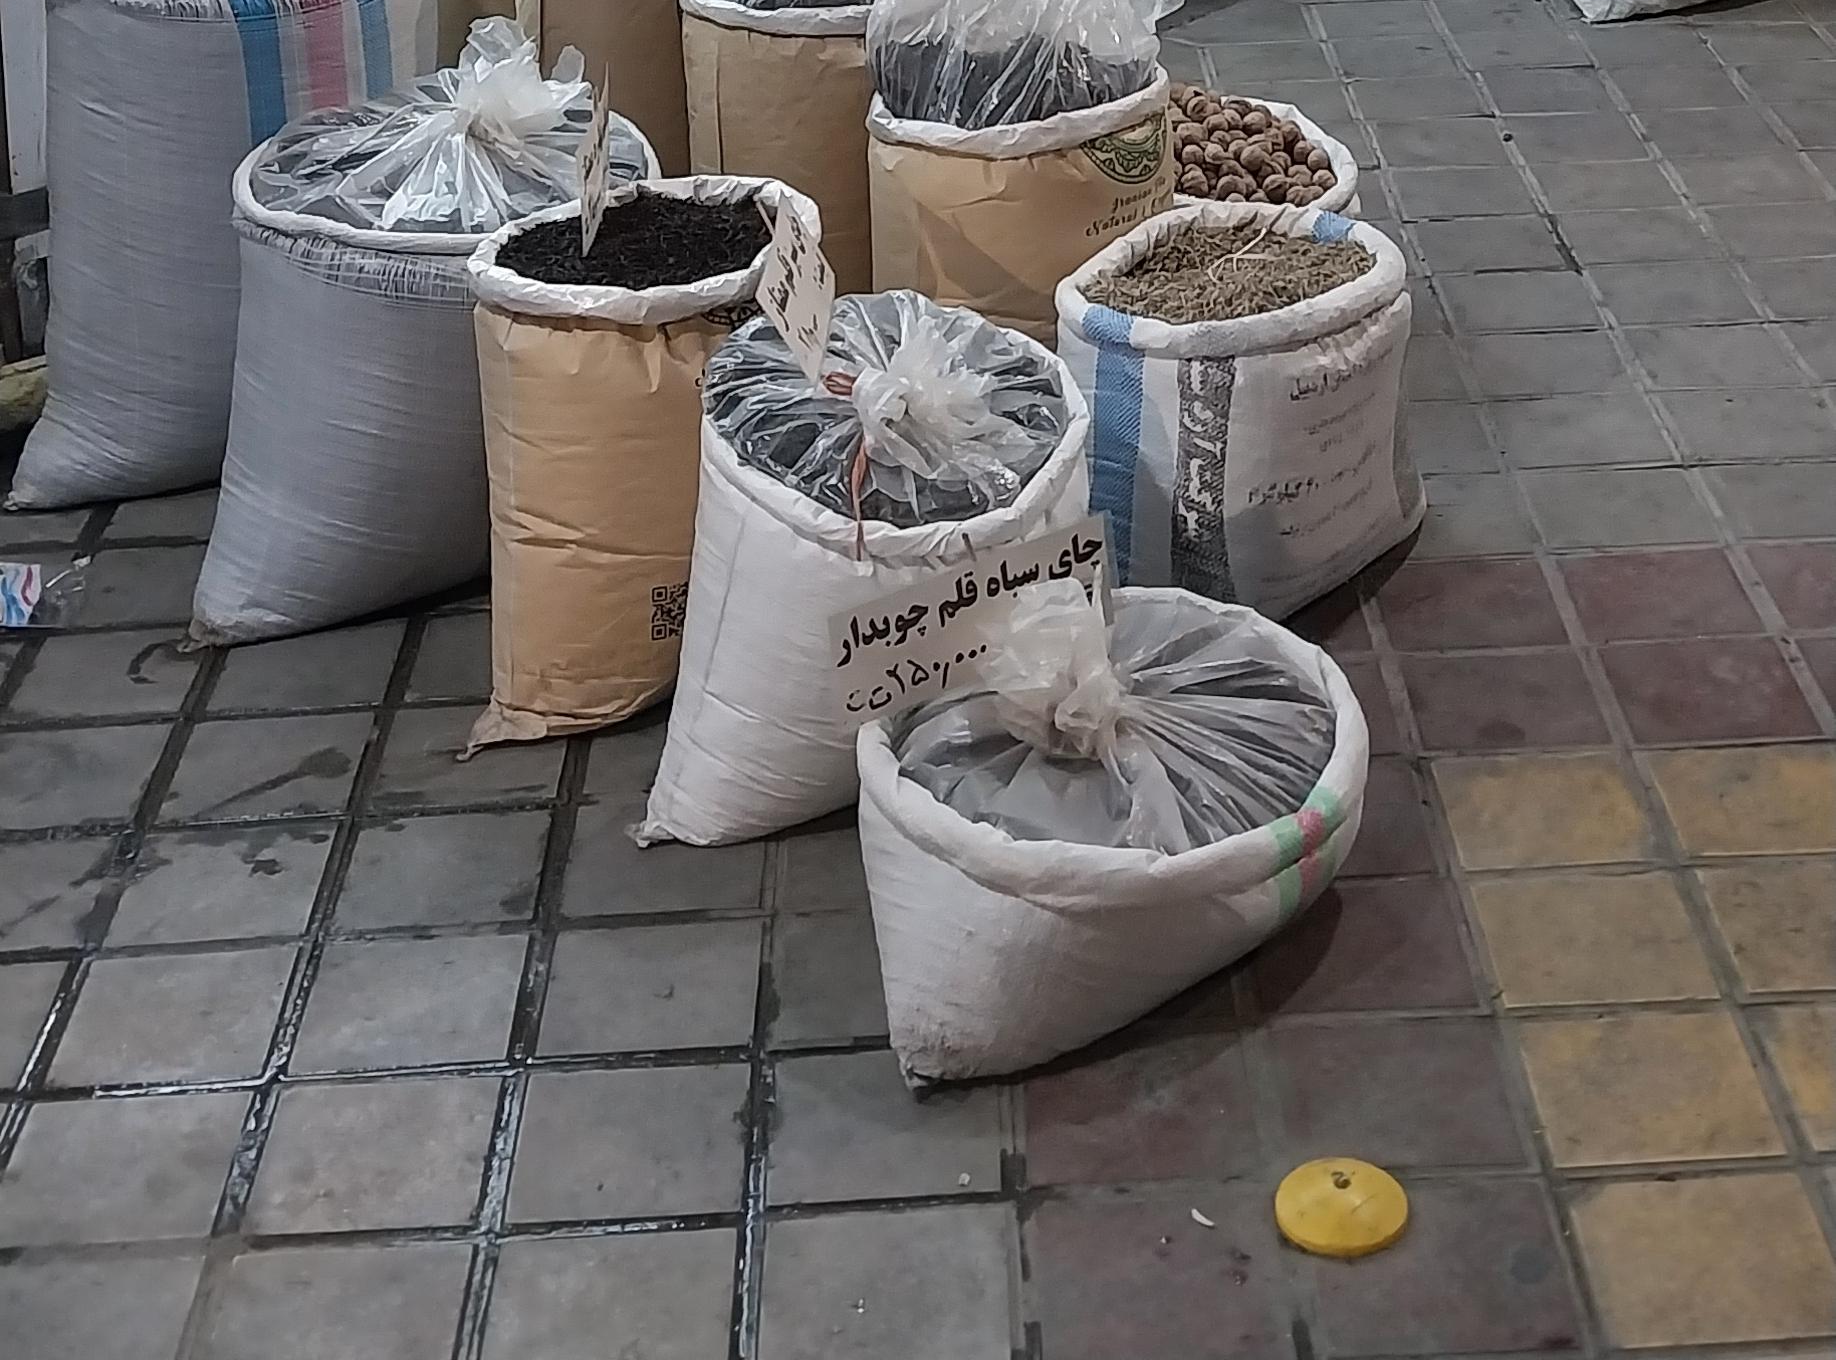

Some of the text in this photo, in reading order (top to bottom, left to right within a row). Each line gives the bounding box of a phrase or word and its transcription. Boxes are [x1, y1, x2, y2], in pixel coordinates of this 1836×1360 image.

[1048, 533, 1103, 580] چای
[939, 571, 978, 628] قلم
[837, 605, 929, 668] چوبدار
